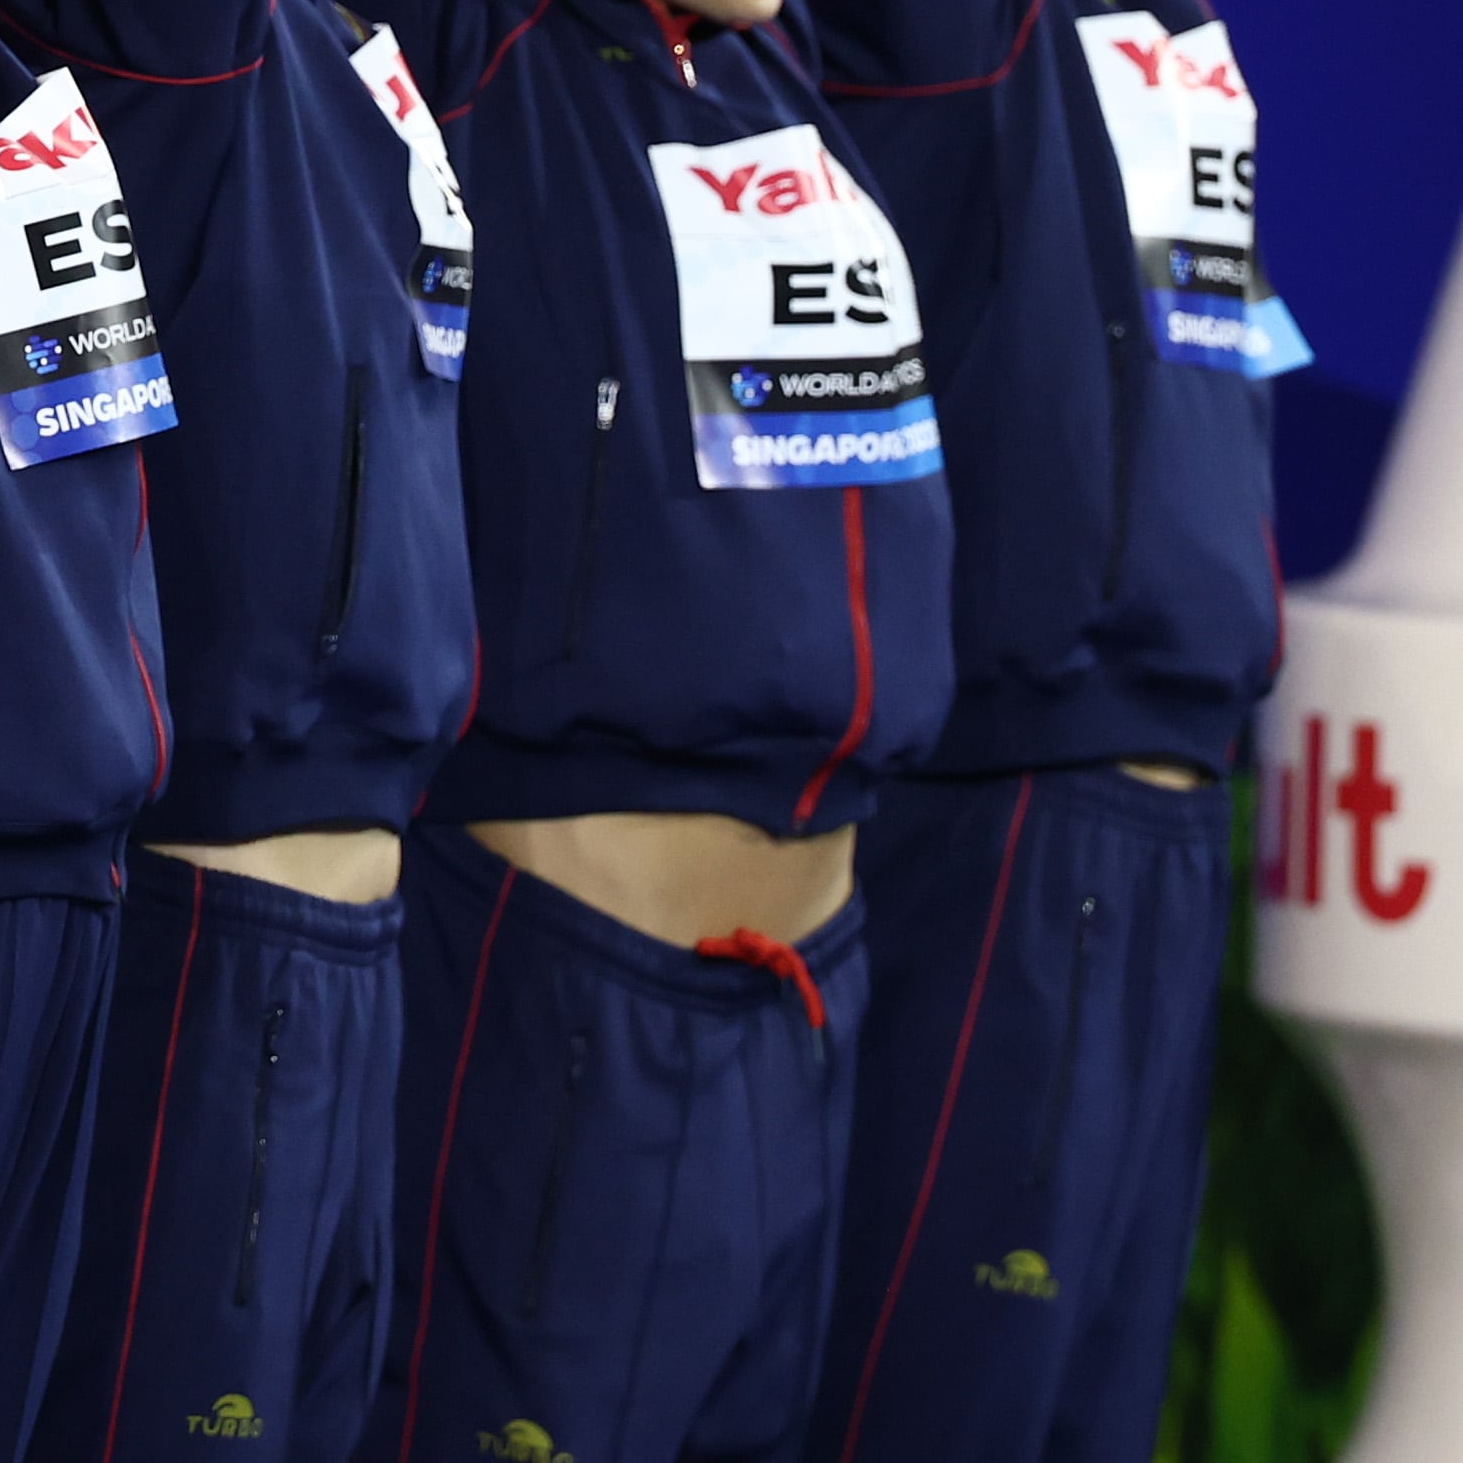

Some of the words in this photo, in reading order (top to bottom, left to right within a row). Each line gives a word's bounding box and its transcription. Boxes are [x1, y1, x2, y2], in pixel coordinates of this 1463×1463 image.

[1190, 147, 1255, 214] ES
[24, 199, 136, 291] ES
[771, 257, 889, 325] ES
[36, 375, 174, 437] SINGAPOR
